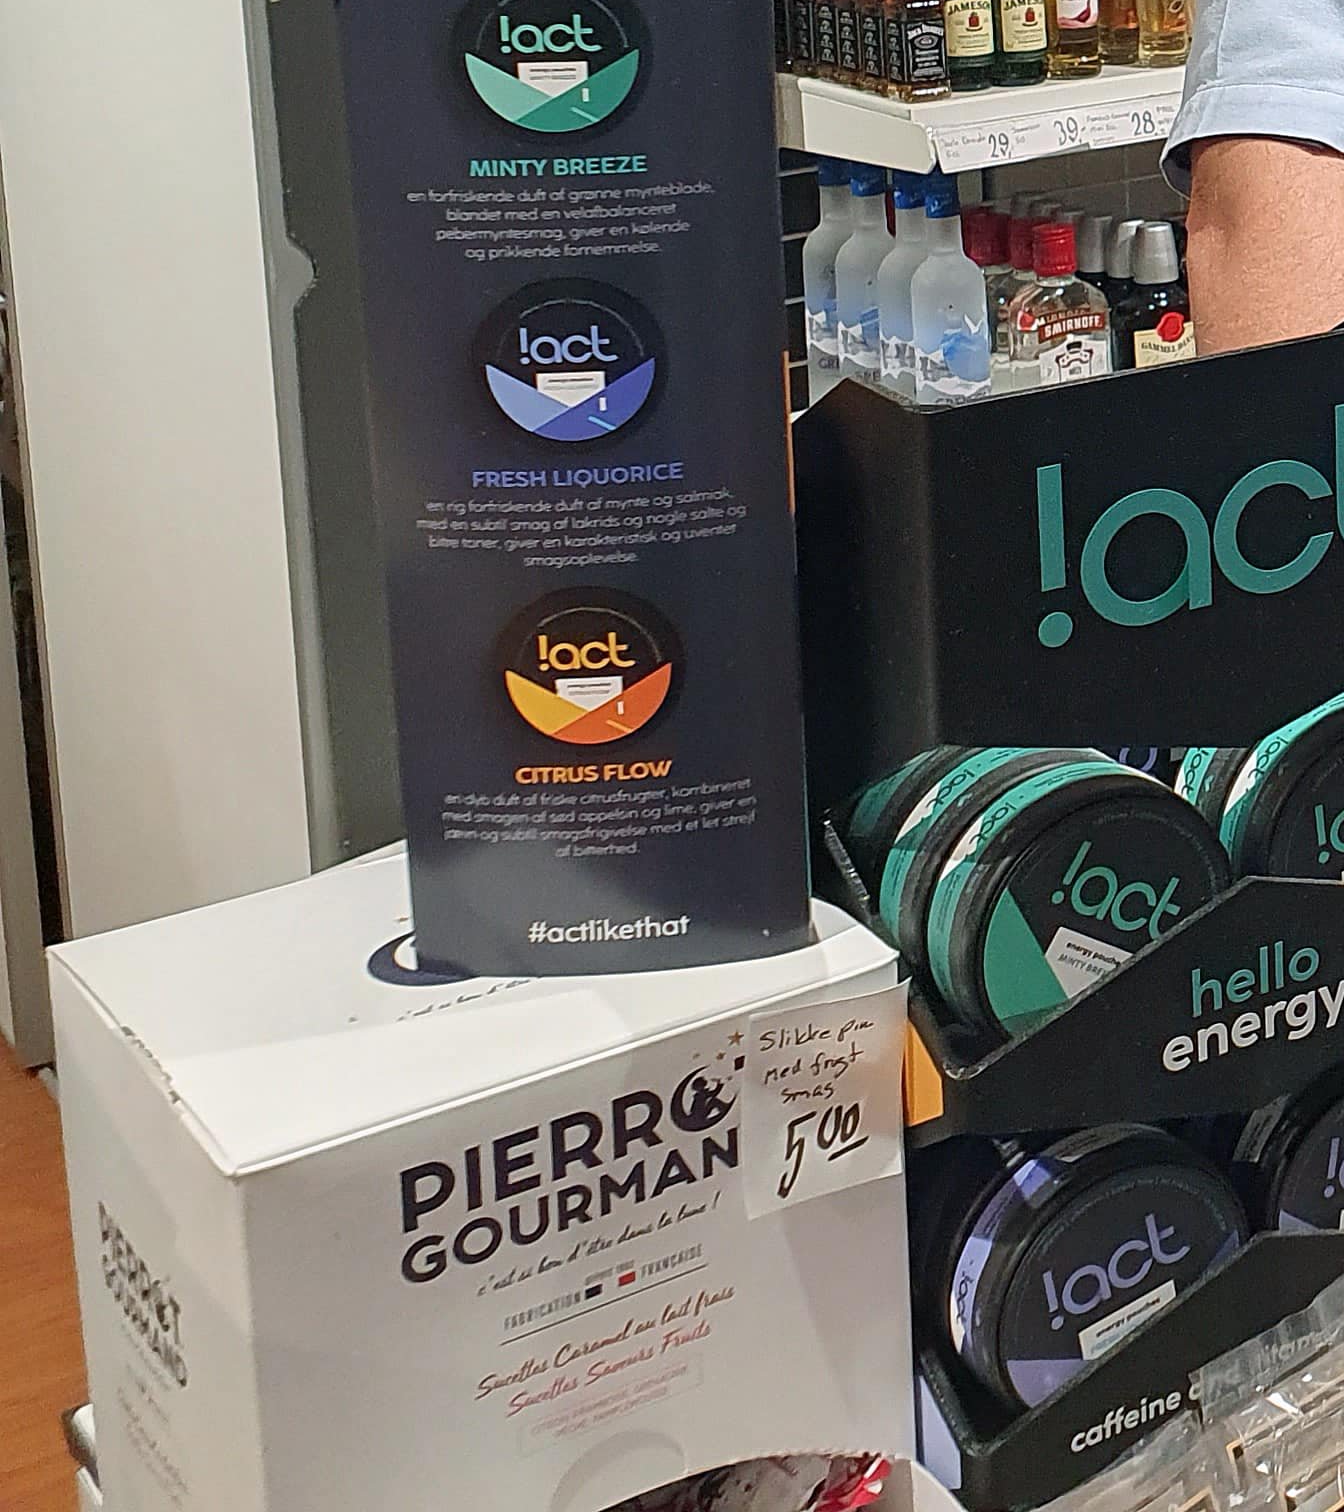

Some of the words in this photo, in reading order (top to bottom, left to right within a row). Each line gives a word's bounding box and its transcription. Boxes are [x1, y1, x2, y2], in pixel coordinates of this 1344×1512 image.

[469, 158, 547, 178] MINTY
[553, 154, 648, 176] BREEZE
[1044, 315, 1103, 340] SMIRNOFF
[472, 467, 547, 488] FRESH
[552, 462, 684, 487] LIQUORICE
[515, 764, 600, 785] CITRUS
[603, 759, 672, 783] FLOW
[527, 914, 691, 944] #actlikethat
[1190, 939, 1321, 1018] hello
[401, 1128, 739, 1284] GOURMAN
[1070, 1384, 1182, 1455] caffeine
